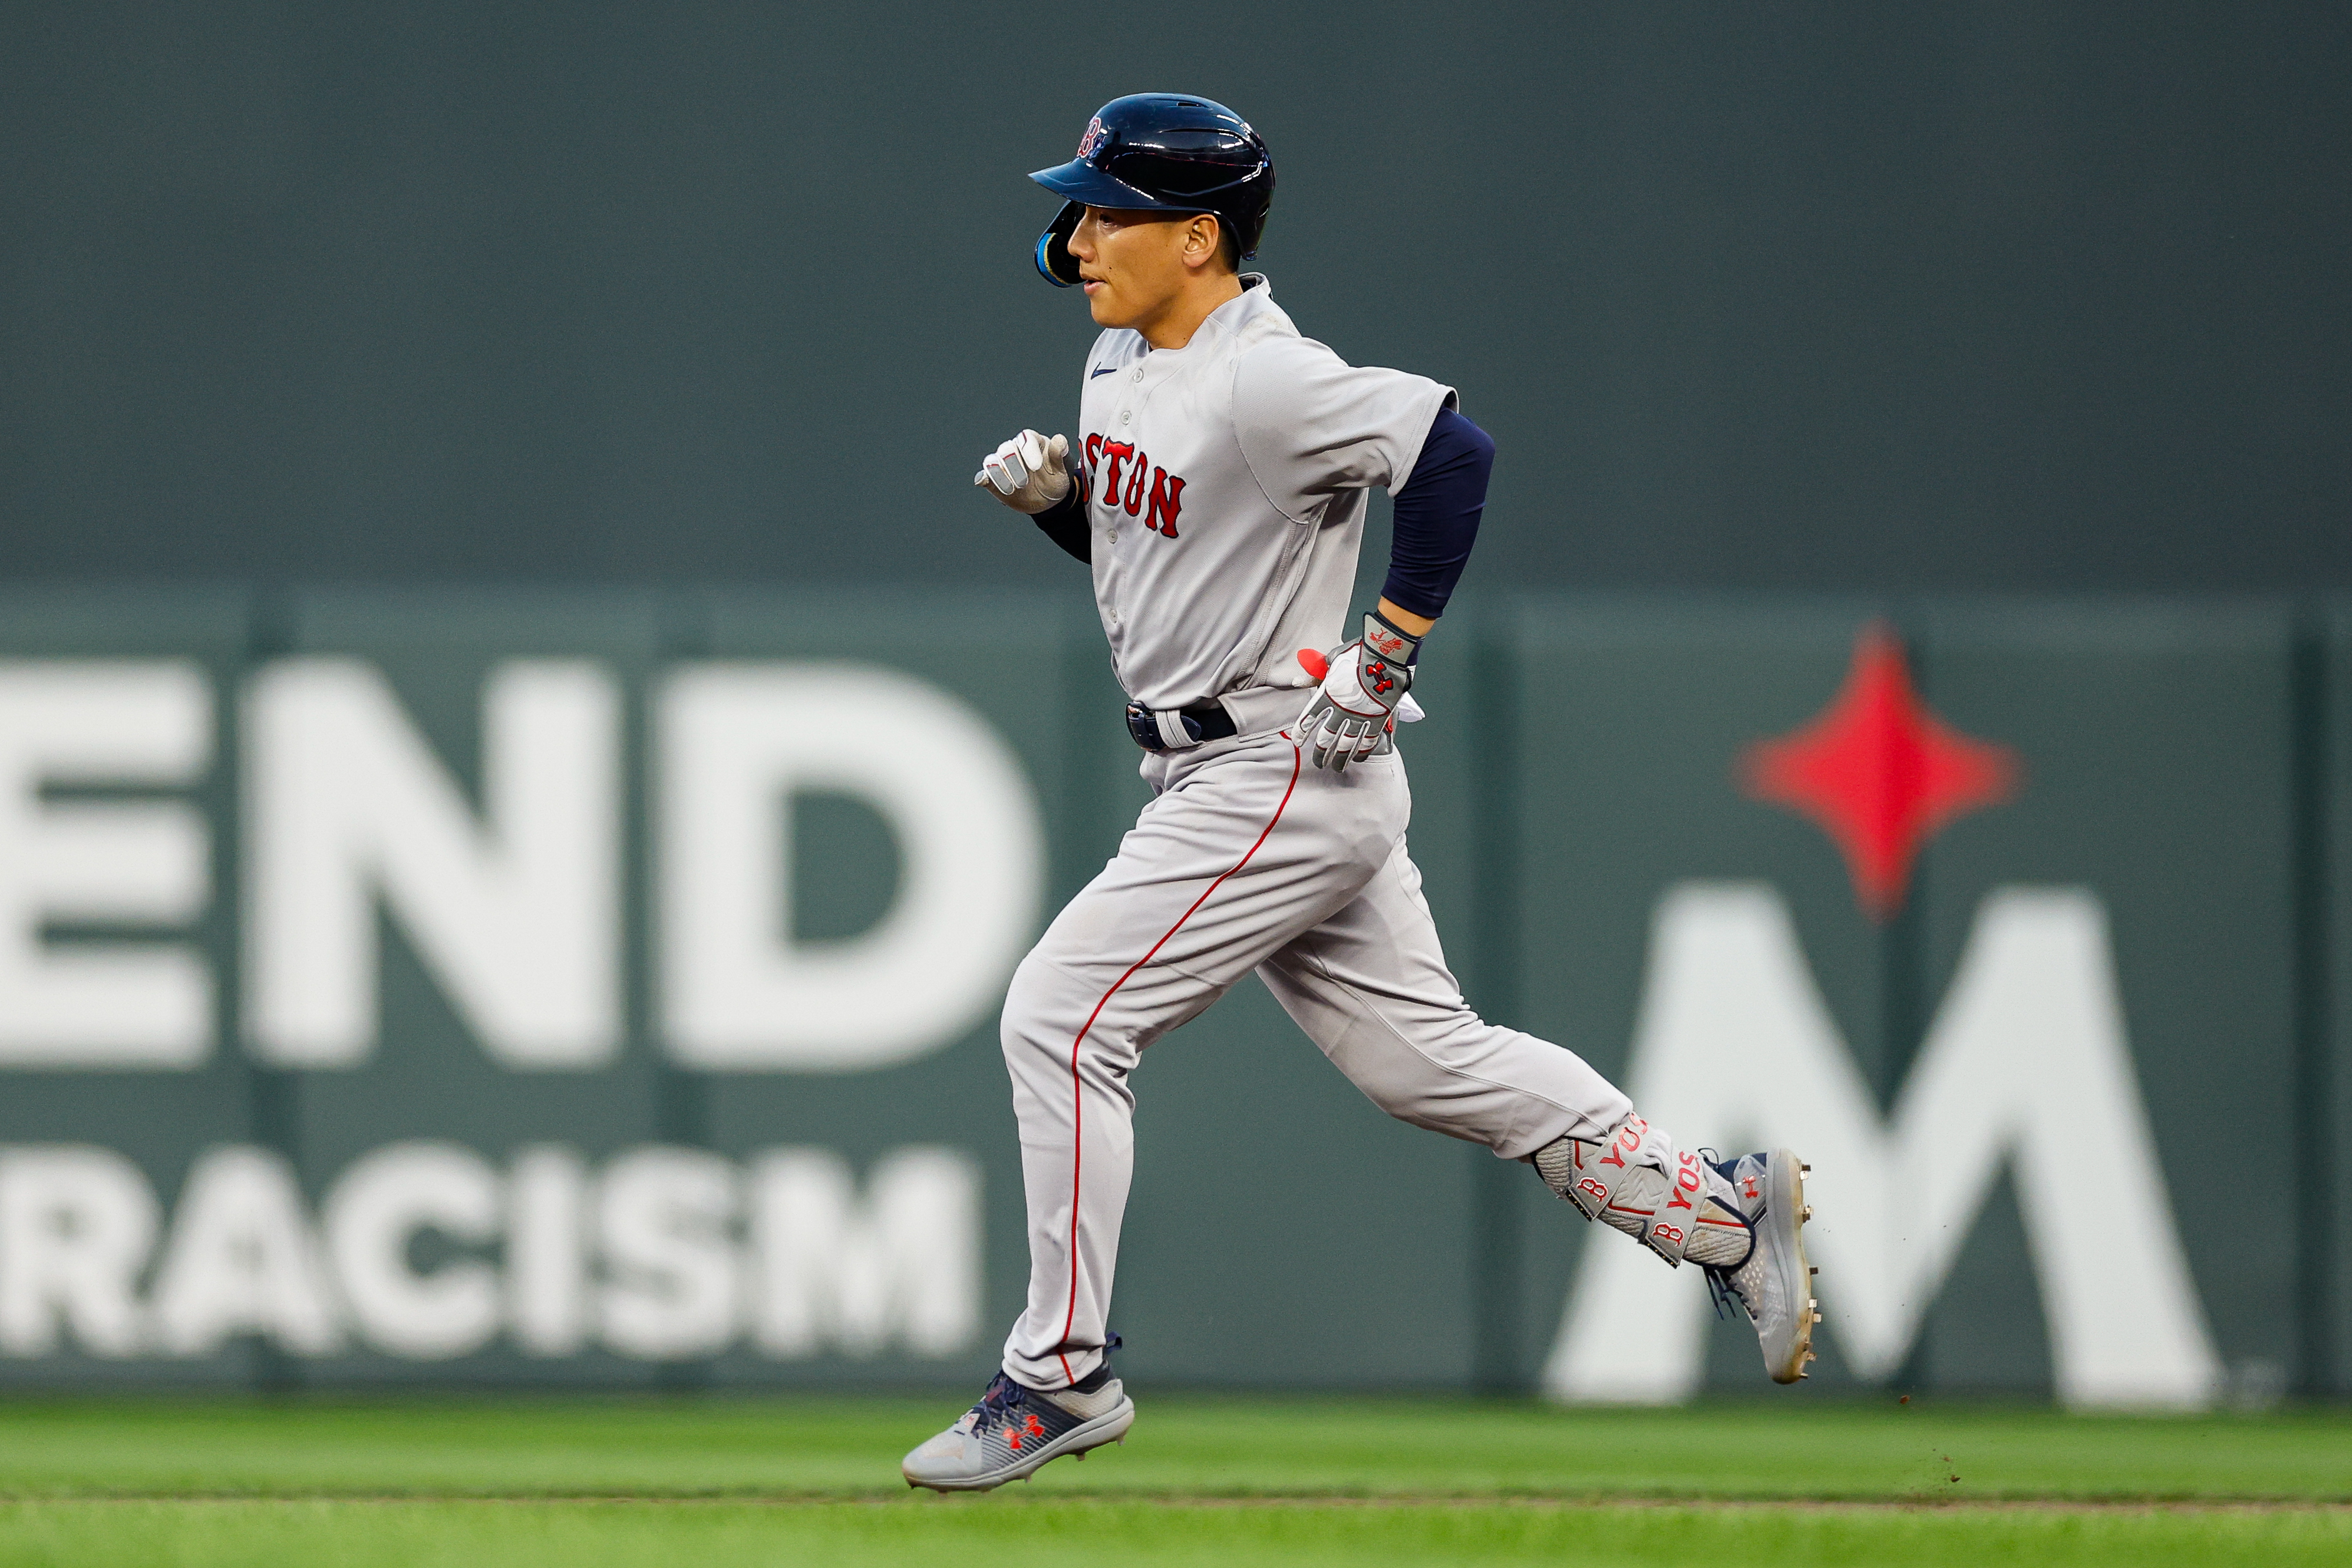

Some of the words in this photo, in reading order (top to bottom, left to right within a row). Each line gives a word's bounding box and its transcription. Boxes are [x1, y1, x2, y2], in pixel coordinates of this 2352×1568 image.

[1077, 116, 1101, 159] B
[0, 656, 1048, 1069] END
[1541, 879, 2223, 1407] M
[1576, 1177, 1608, 1203] B
[1667, 1151, 1700, 1211] YOS
[0, 1143, 983, 1360] RACISM
[1652, 1222, 1684, 1247] B
